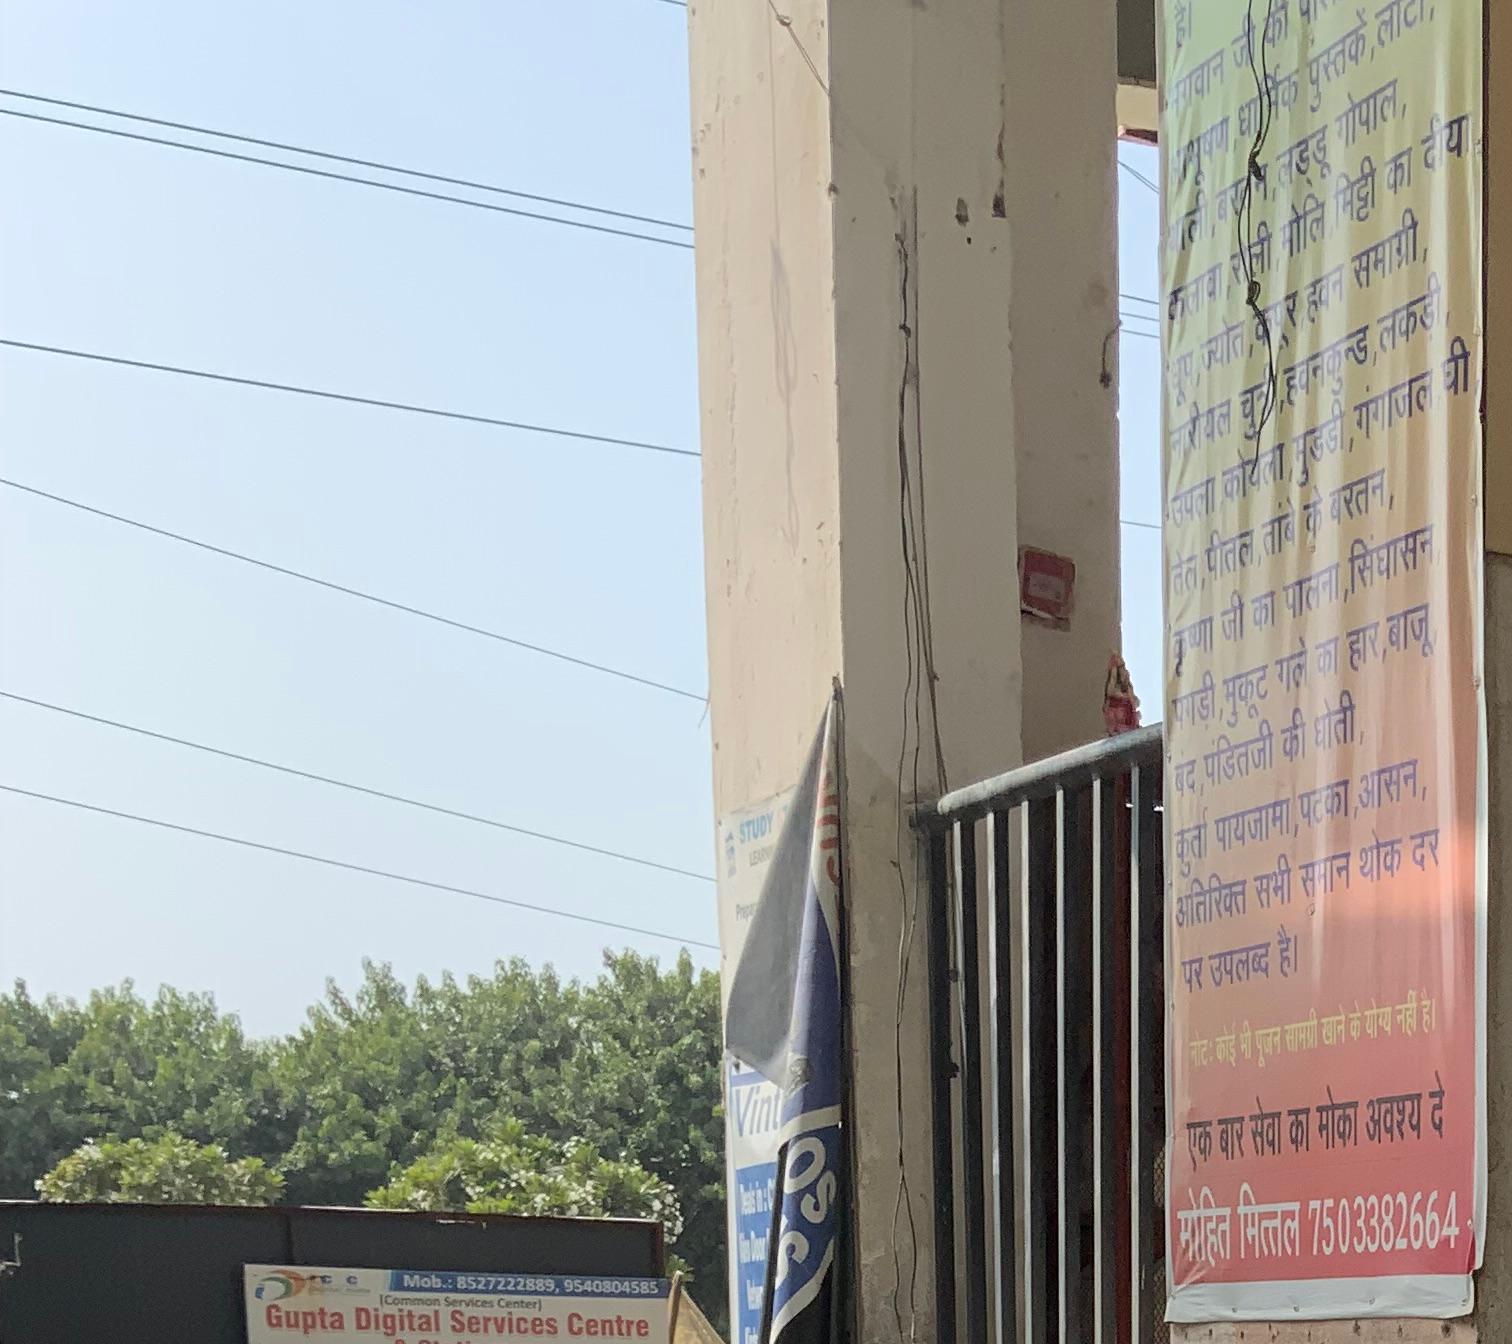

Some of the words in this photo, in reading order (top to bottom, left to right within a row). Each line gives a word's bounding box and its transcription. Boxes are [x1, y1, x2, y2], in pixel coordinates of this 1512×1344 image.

[740, 812, 773, 844] STUDY
[1181, 958, 1204, 992] पर
[1186, 1121, 1212, 1172] एक
[1218, 1116, 1245, 1161] बार
[1250, 1096, 1281, 1156] सेवा
[1288, 1107, 1310, 1152] का
[1366, 1093, 1422, 1143] अवश्य
[1177, 1187, 1231, 1267] मोहित
[1309, 1190, 1459, 1256] 7503382664
[403, 1274, 453, 1288] Mob.:
[457, 1276, 559, 1293] 8527222889,
[564, 1280, 658, 1294] 9540804585
[266, 1304, 345, 1334] Gupta
[355, 1307, 440, 1336] Digital
[450, 1310, 558, 1335] Services
[567, 1312, 649, 1337] Centre
